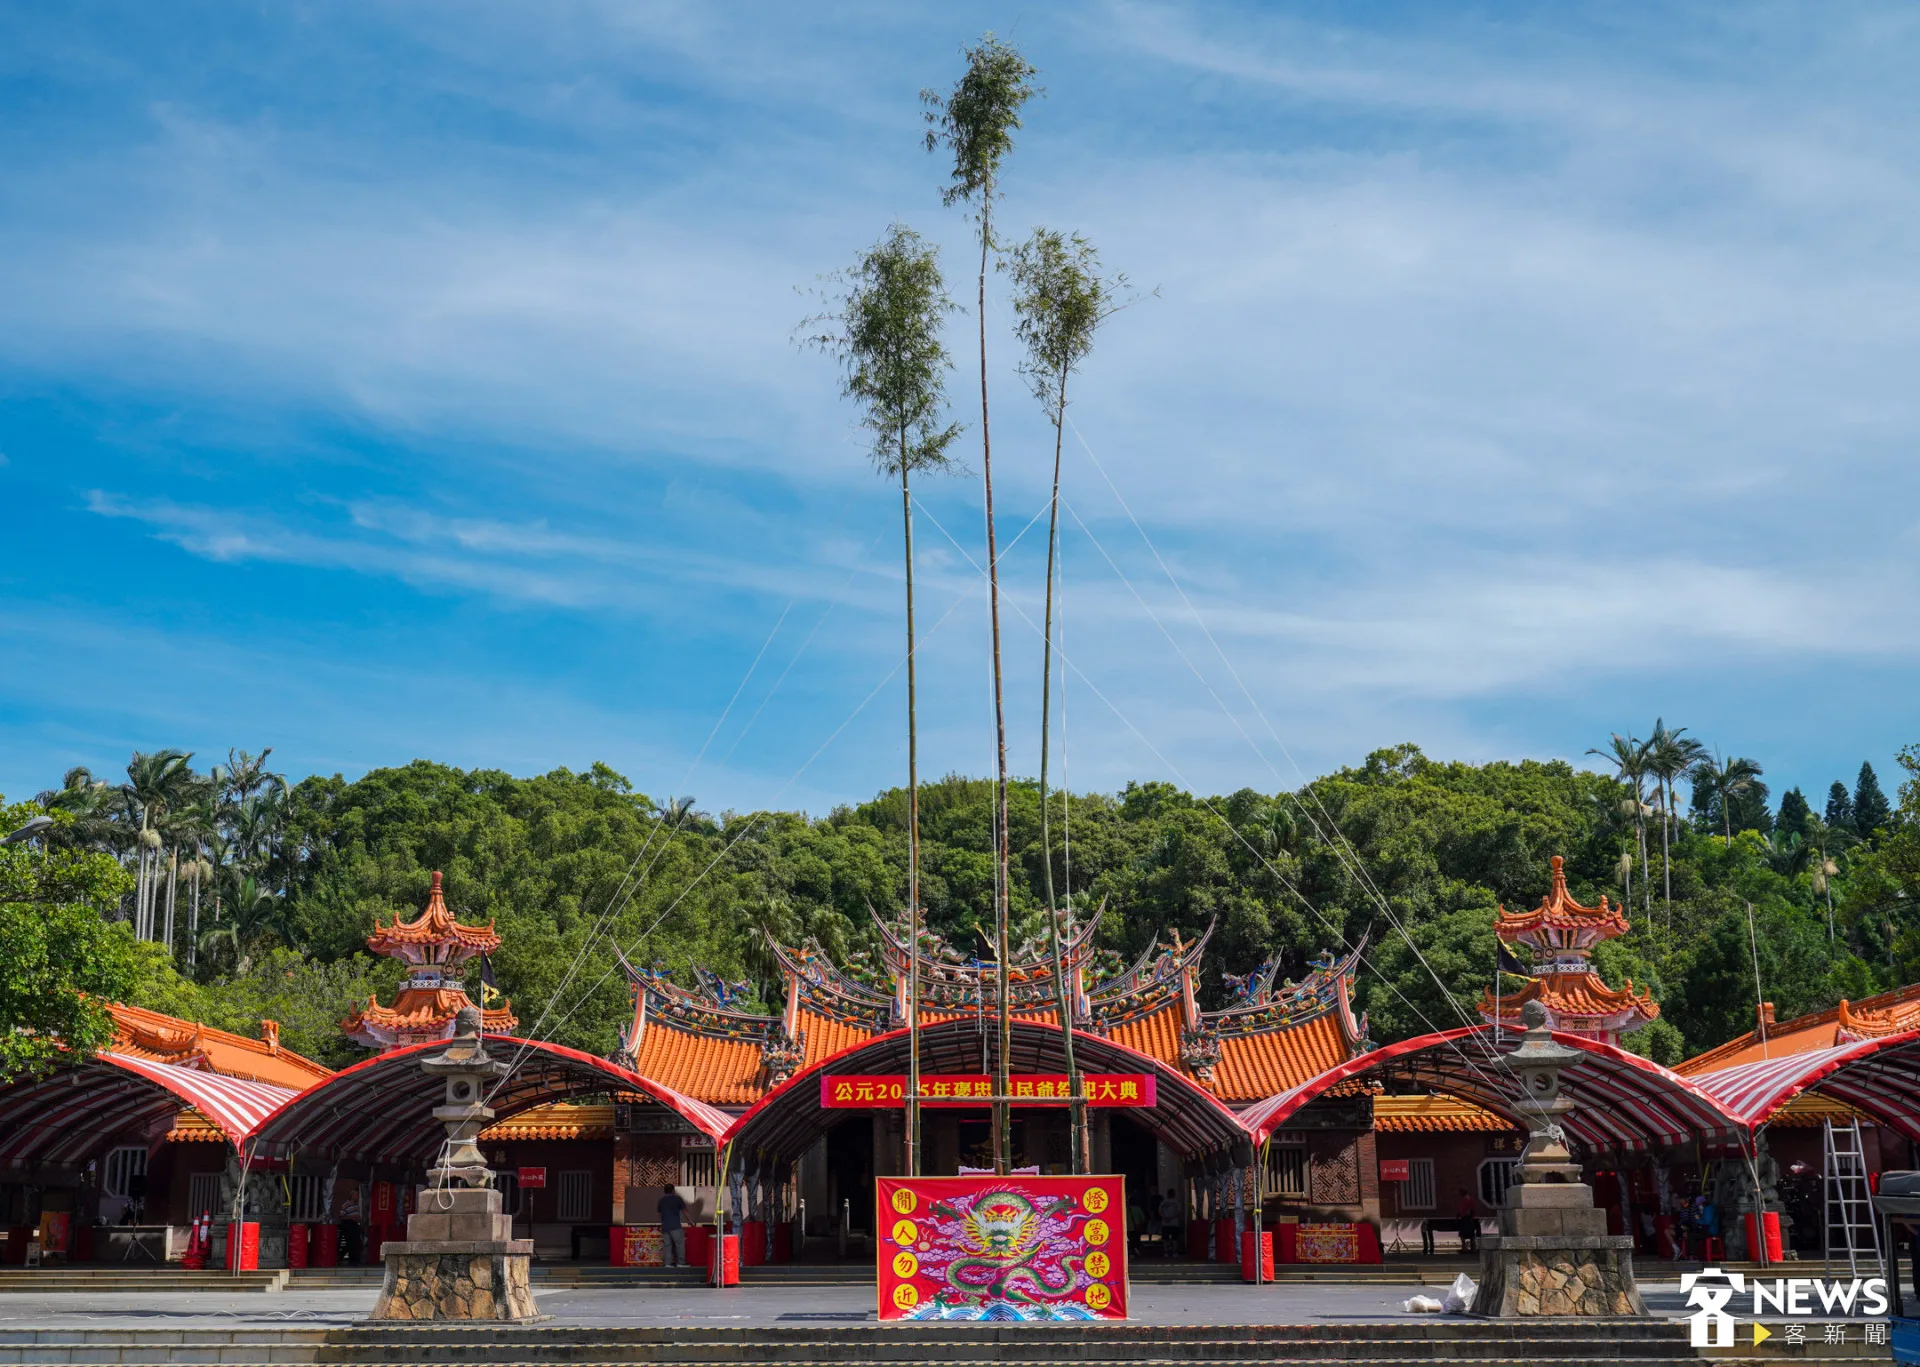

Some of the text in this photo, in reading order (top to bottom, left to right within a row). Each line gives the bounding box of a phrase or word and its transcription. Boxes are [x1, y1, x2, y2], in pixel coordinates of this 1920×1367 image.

[834, 1081, 1139, 1101] 公元205年褒忠民爺祭祀大典
[1085, 1190, 1109, 1306] 燈篙禁地
